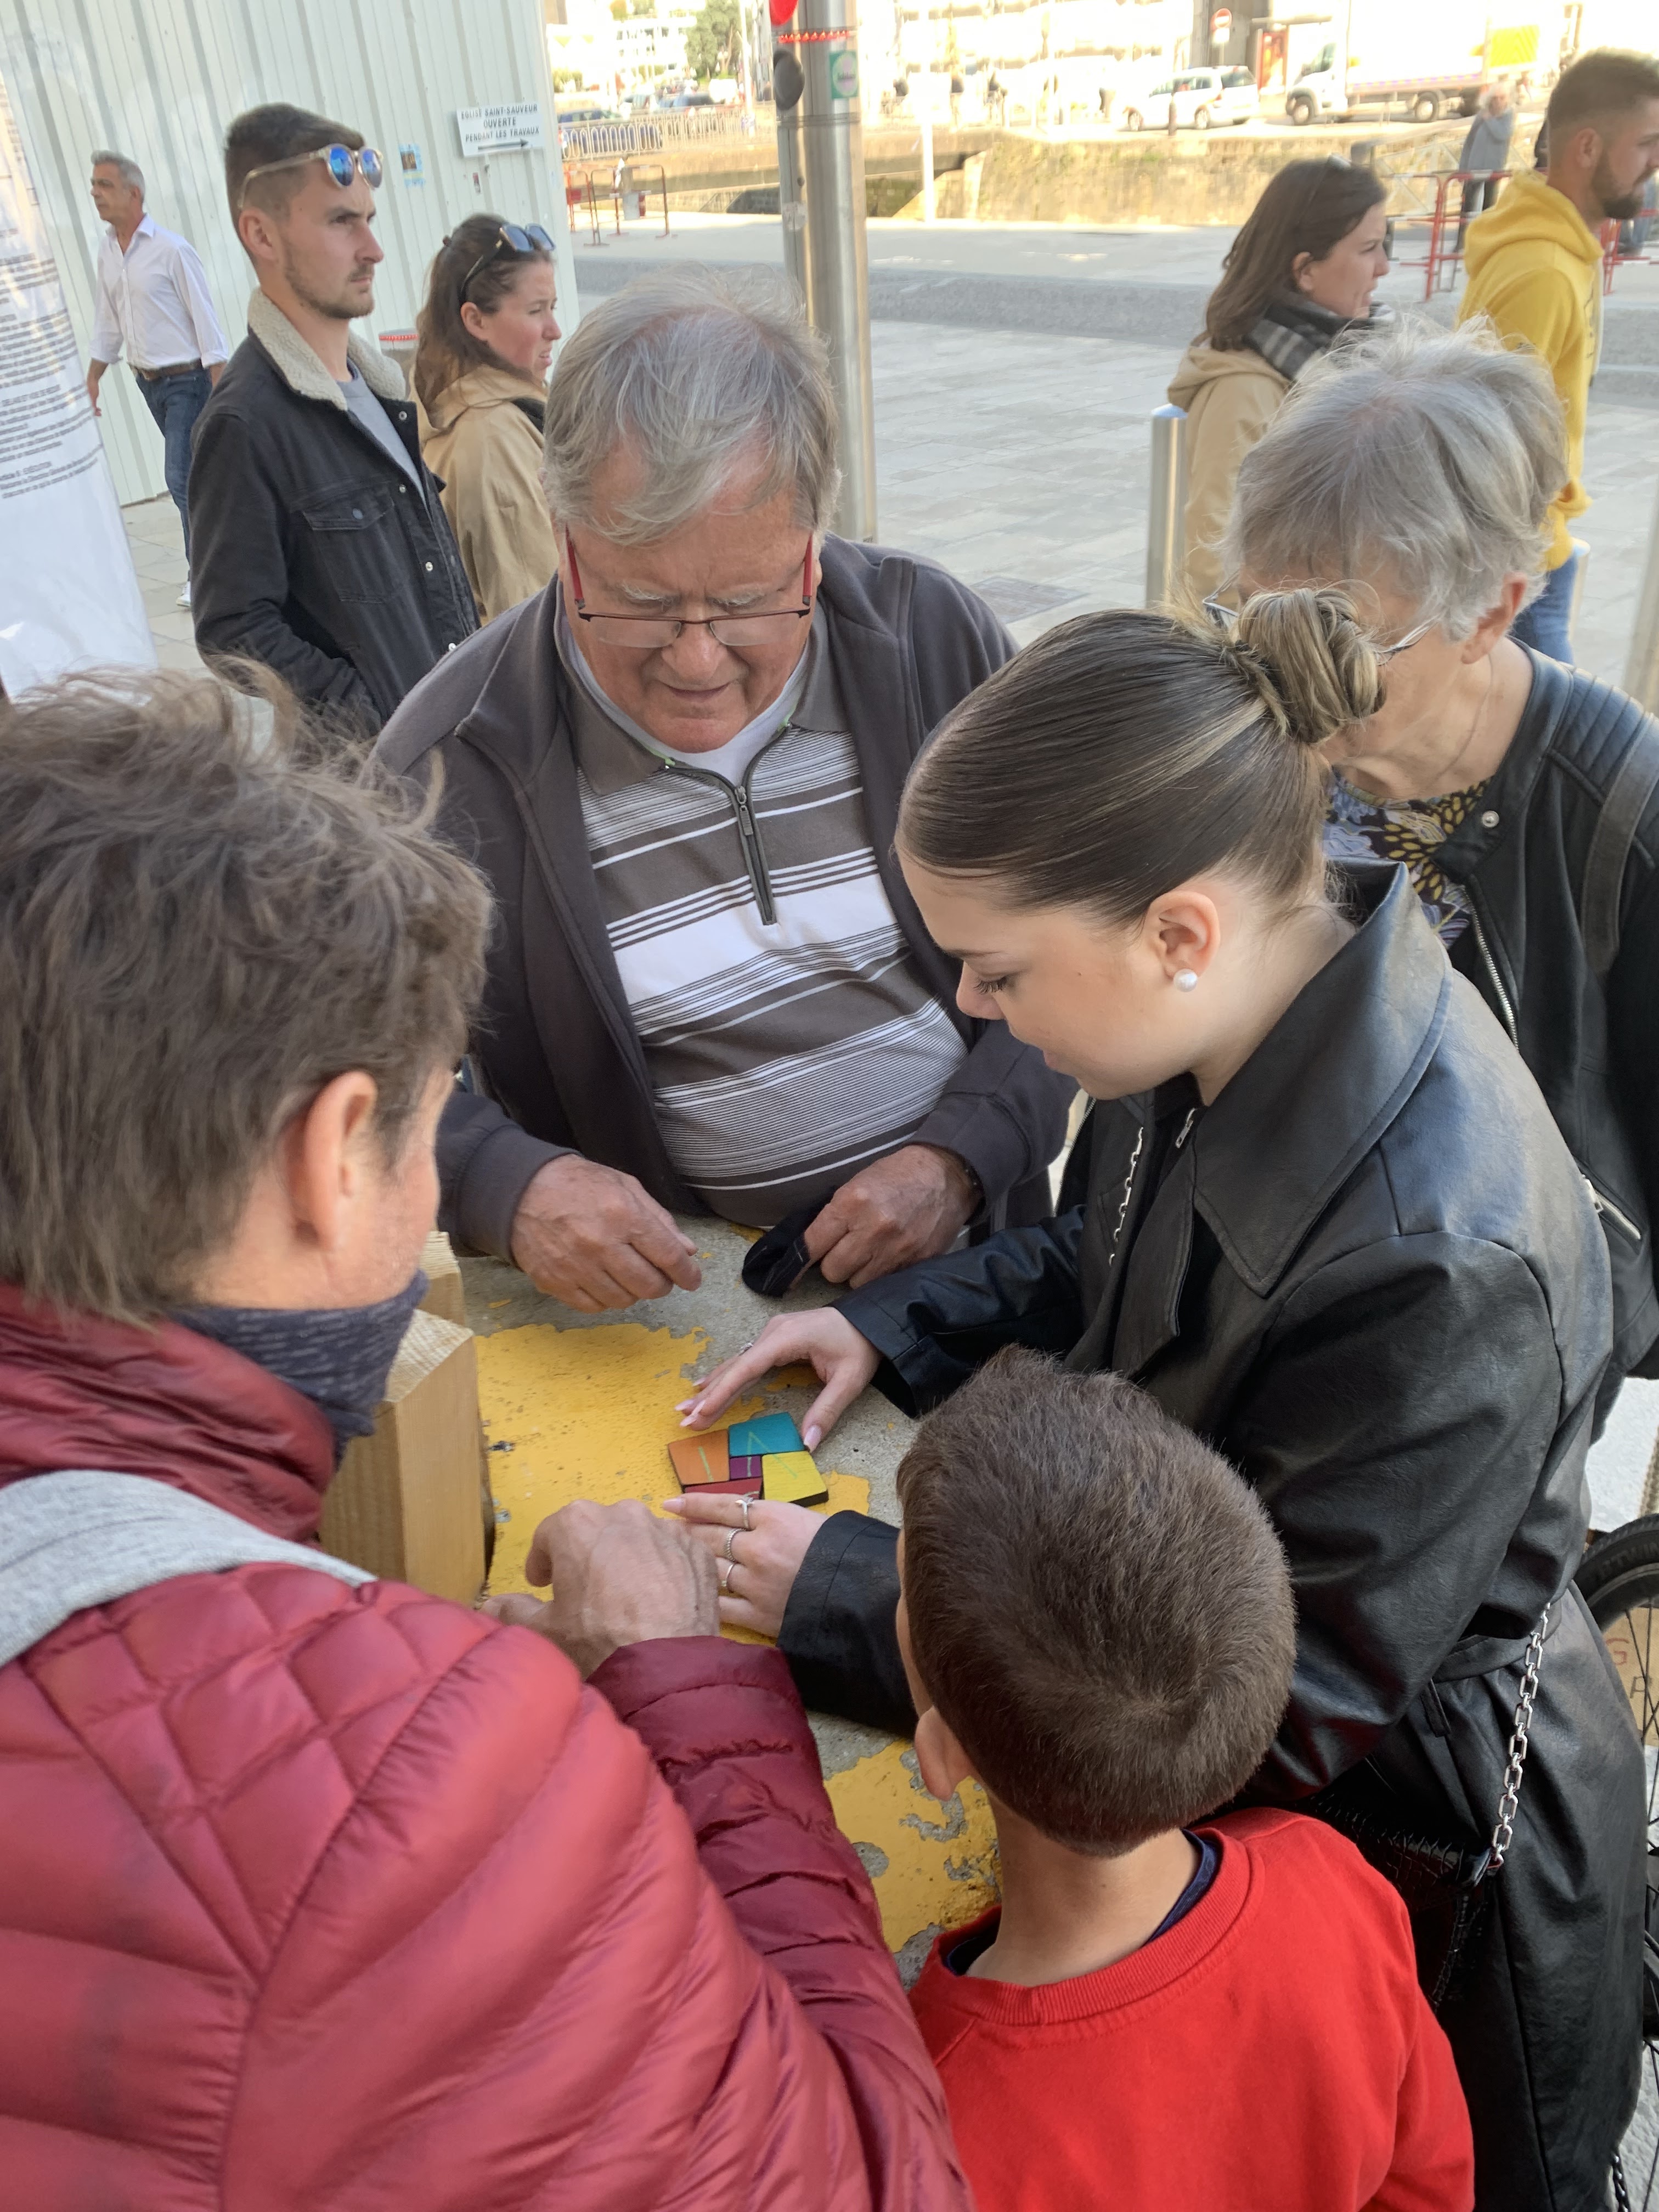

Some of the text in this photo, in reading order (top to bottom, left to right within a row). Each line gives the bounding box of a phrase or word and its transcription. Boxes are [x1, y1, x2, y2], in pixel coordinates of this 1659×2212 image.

[461, 104, 538, 120] EGLISE SAINT-SAUVEUR
[483, 117, 516, 128] OUVERTE
[465, 126, 539, 142] PENDANT LES TRAVAUX
